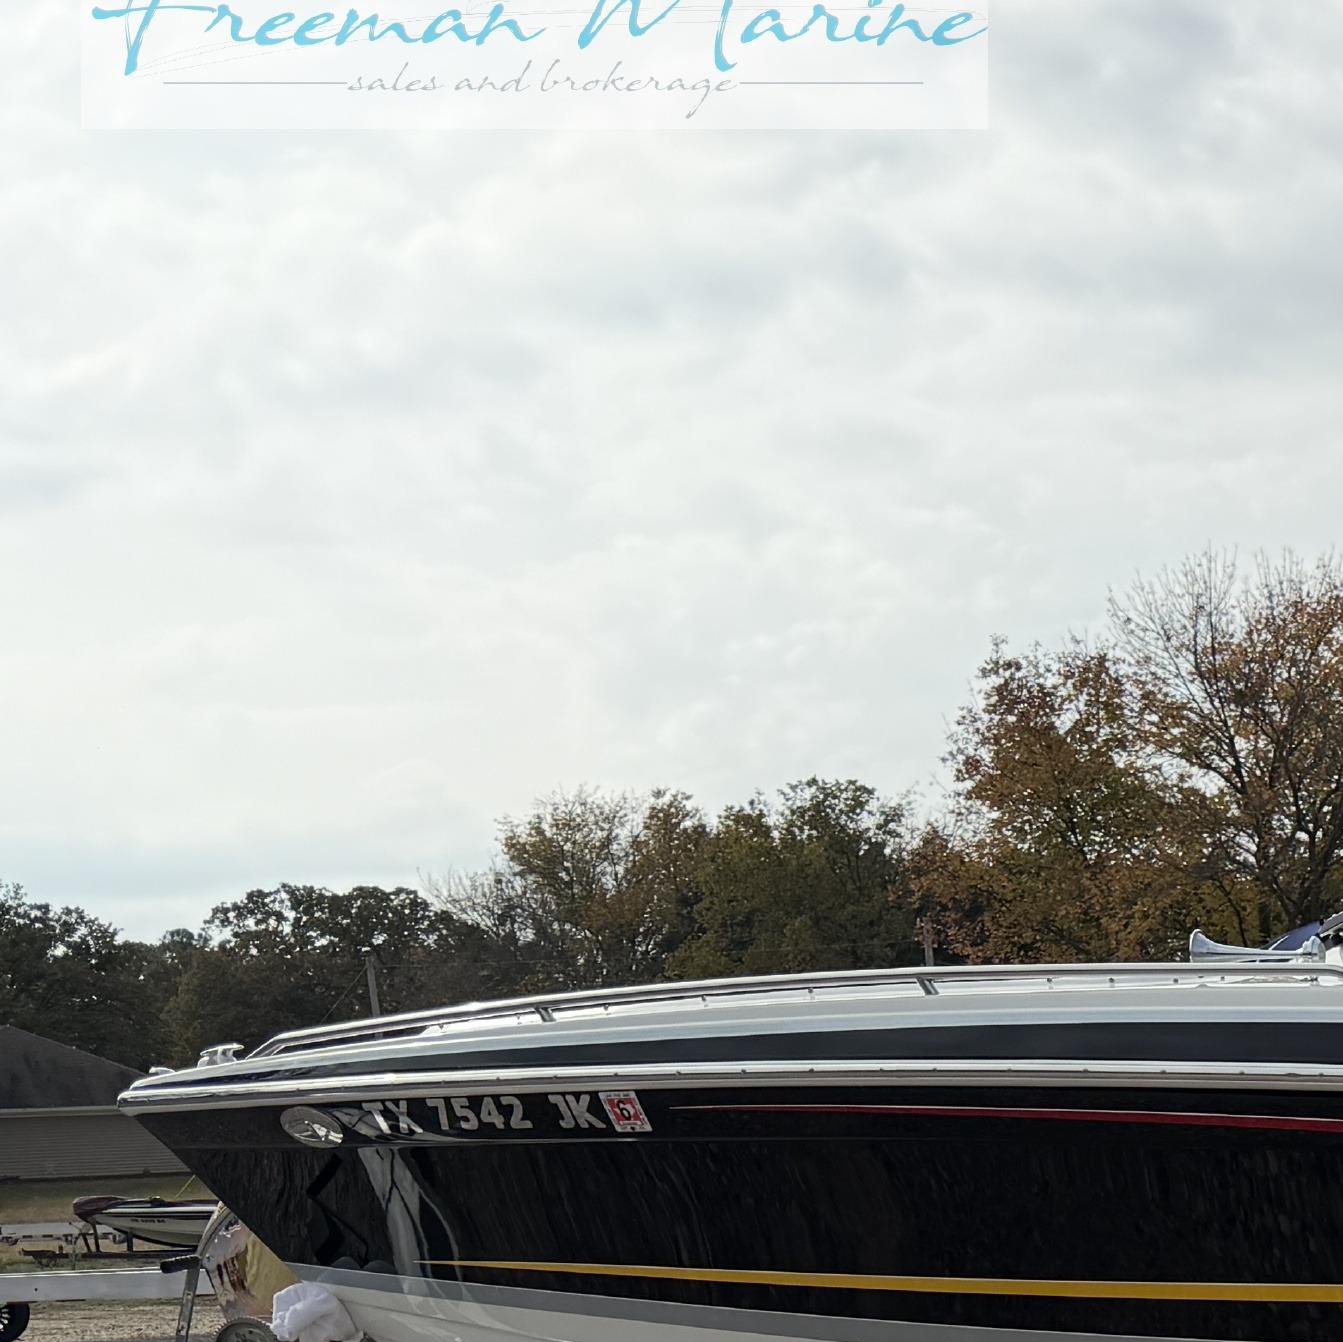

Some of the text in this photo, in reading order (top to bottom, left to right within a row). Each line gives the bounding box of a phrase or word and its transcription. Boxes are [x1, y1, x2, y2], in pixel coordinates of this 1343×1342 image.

[361, 1094, 607, 1134] TX 7542 JK
[616, 1099, 632, 1121] 6
